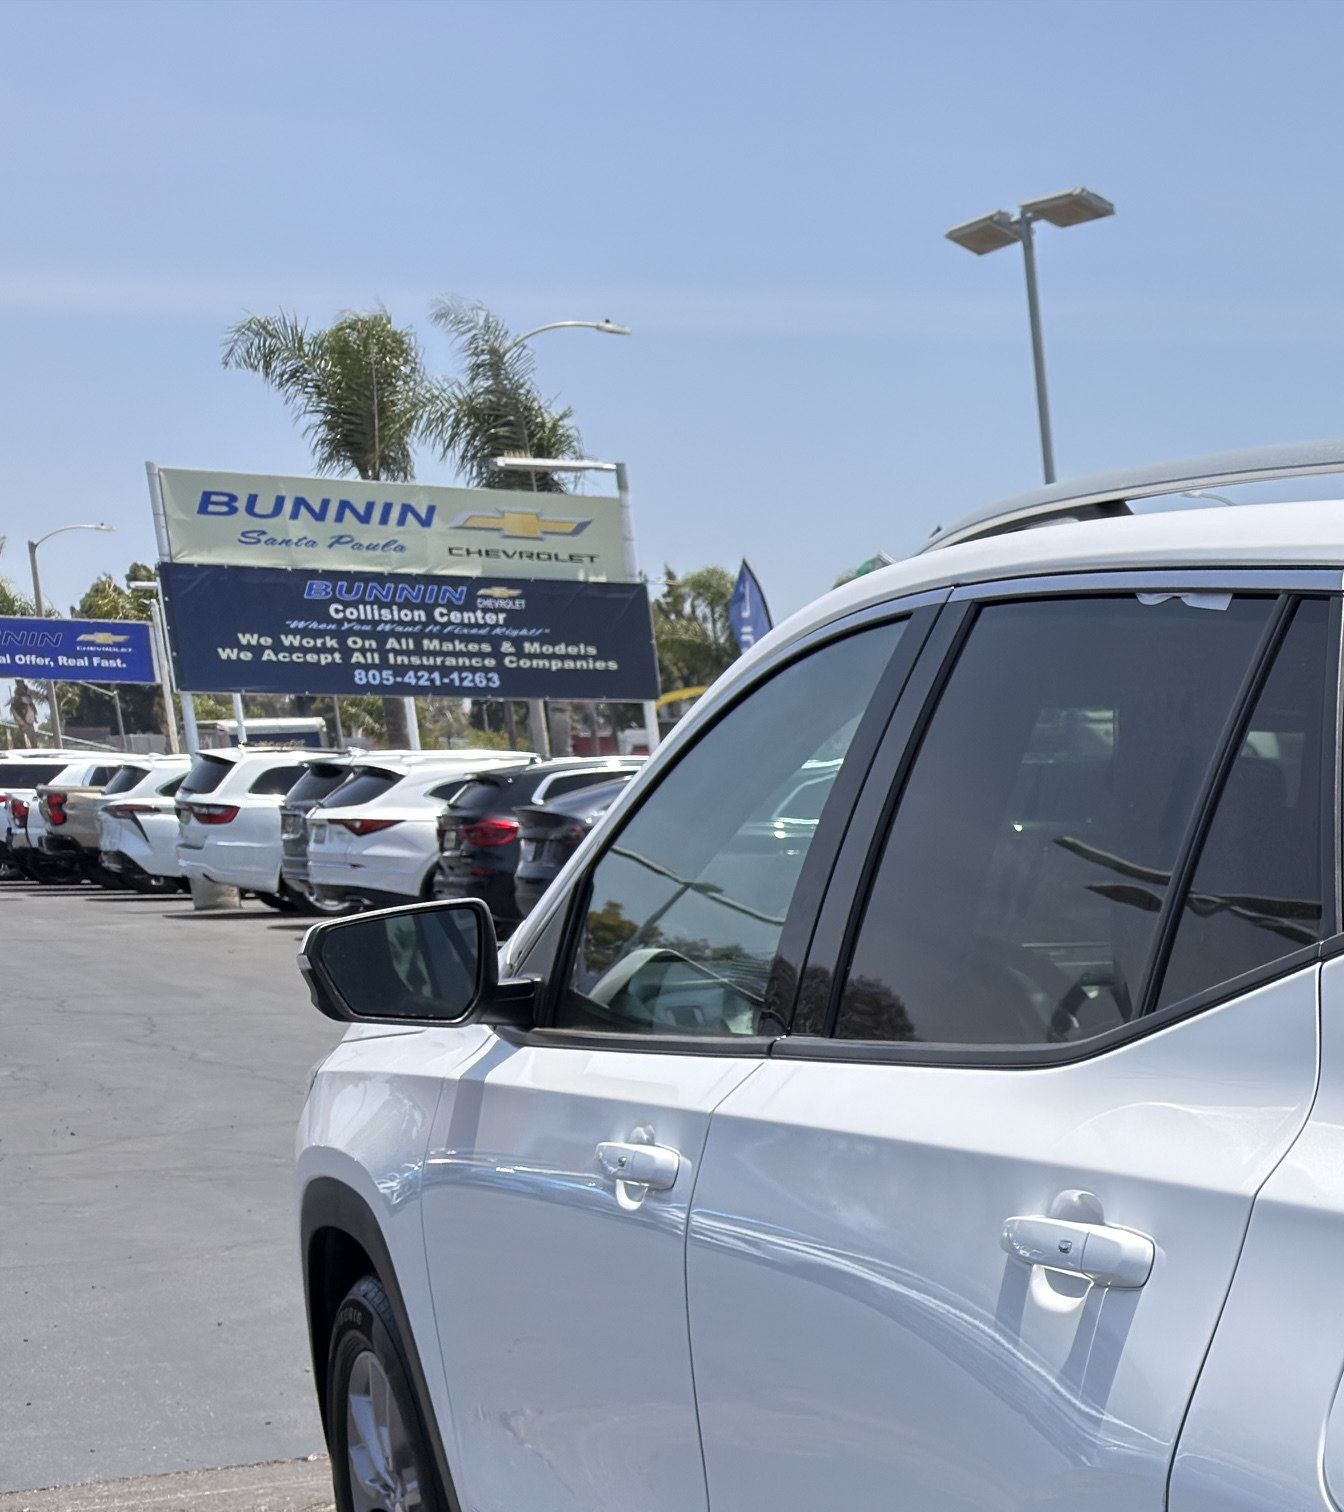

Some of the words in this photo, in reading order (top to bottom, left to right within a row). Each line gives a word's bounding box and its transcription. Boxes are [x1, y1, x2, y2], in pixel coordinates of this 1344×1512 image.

[197, 490, 436, 529] BUNNIN
[237, 529, 318, 549] Santa
[327, 533, 407, 554] Paula
[447, 546, 600, 564] CHEVROLET
[304, 580, 468, 605] BUNNIN
[328, 603, 427, 623] Collision
[433, 606, 507, 625] Center
[476, 598, 526, 611] CHEVROLET
[342, 621, 374, 633] You
[376, 622, 423, 634] Want
[0, 630, 63, 648] NIN
[237, 633, 273, 646] We
[280, 634, 340, 649] Work
[346, 636, 378, 650] On
[385, 637, 415, 650] All
[422, 638, 492, 653] Makes
[500, 640, 516, 654] &
[523, 641, 598, 657] Models
[15, 653, 54, 667] Offer,
[57, 655, 89, 667] Real
[93, 656, 127, 669] Fast.
[217, 647, 253, 661] We
[261, 649, 343, 666] Accept
[350, 651, 381, 665] All
[388, 651, 497, 668] Insurance
[503, 655, 619, 671] Companies
[353, 668, 501, 688] 805-421-1263
